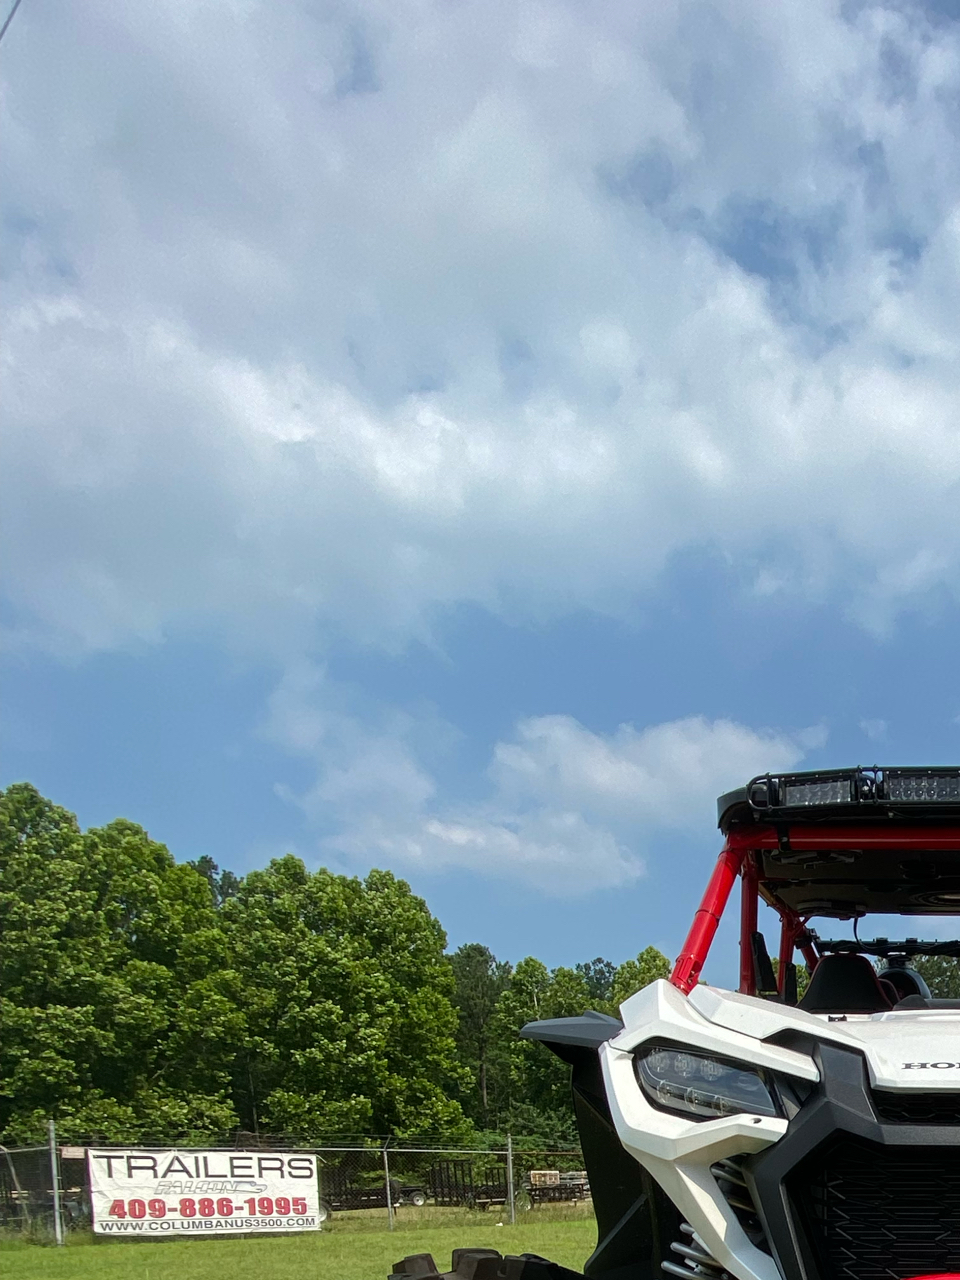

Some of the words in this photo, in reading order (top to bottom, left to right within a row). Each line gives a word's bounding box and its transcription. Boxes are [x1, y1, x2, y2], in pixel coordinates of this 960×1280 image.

[94, 1155, 313, 1179] TRAILERS
[154, 1181, 237, 1194] FALCON
[109, 1197, 307, 1219] 409-886-1995
[100, 1218, 315, 1231] WWW.COLUMBANUS3500.COM
